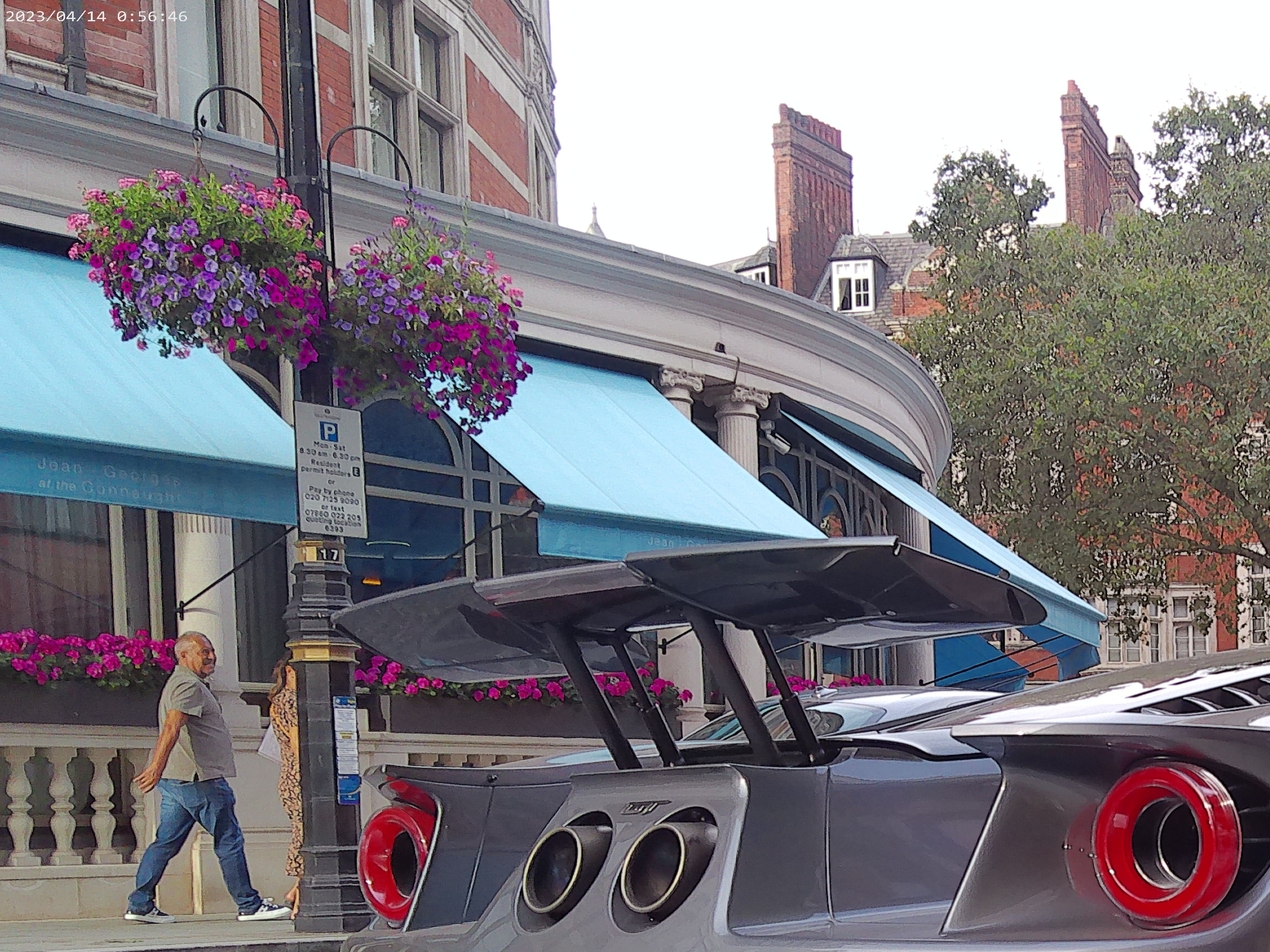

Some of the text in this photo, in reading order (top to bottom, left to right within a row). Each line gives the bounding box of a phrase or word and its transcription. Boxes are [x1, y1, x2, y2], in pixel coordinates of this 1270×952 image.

[324, 424, 336, 440] P
[313, 440, 328, 449] Mon
[333, 443, 346, 452] Sat
[299, 447, 317, 456] 8.30
[332, 451, 349, 460] 6.30
[310, 458, 341, 469] Resident
[300, 466, 324, 475] permit
[325, 468, 351, 478] holders
[38, 478, 51, 489] at
[56, 479, 77, 492] the
[308, 485, 355, 497] Pay by phone
[304, 493, 360, 506] 020 7125 9090
[305, 516, 362, 527] quoting location
[648, 536, 674, 548] Jean
[319, 548, 339, 561] 17
